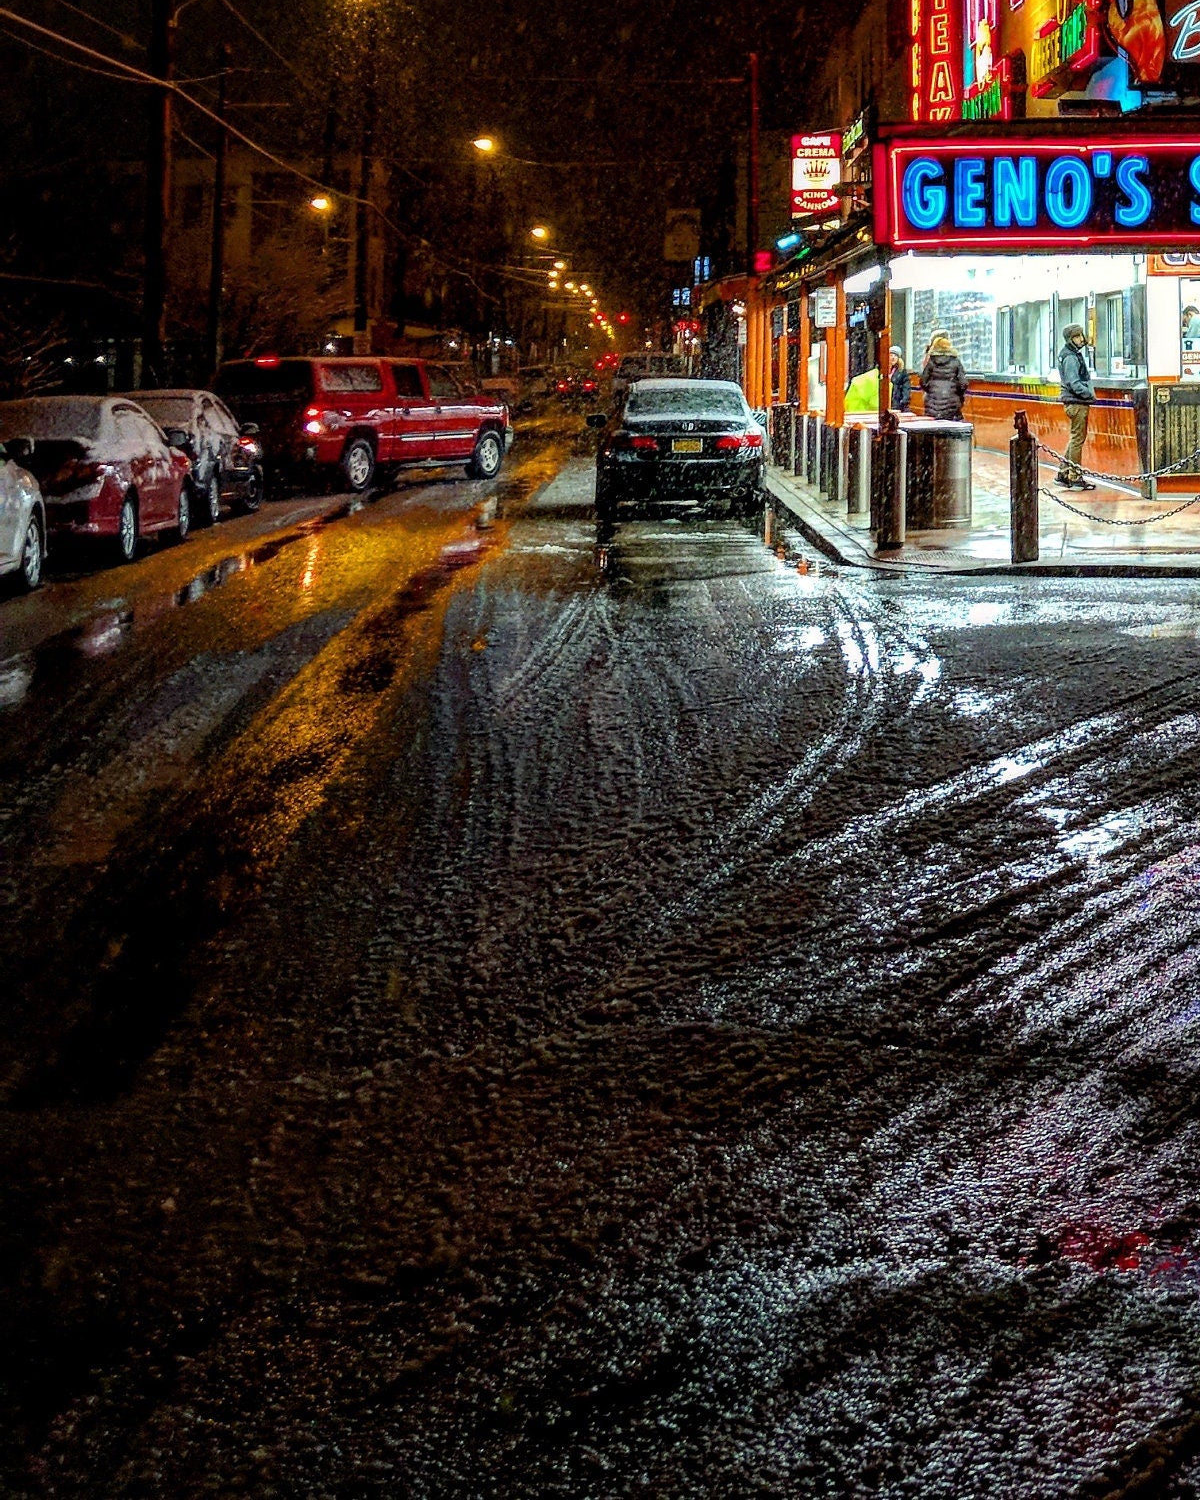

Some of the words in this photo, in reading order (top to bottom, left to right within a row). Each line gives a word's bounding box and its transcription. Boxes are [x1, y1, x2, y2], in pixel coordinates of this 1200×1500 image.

[796, 148, 836, 157] CREMA
[903, 150, 1153, 230] GENO'S
[802, 191, 828, 199] KING
